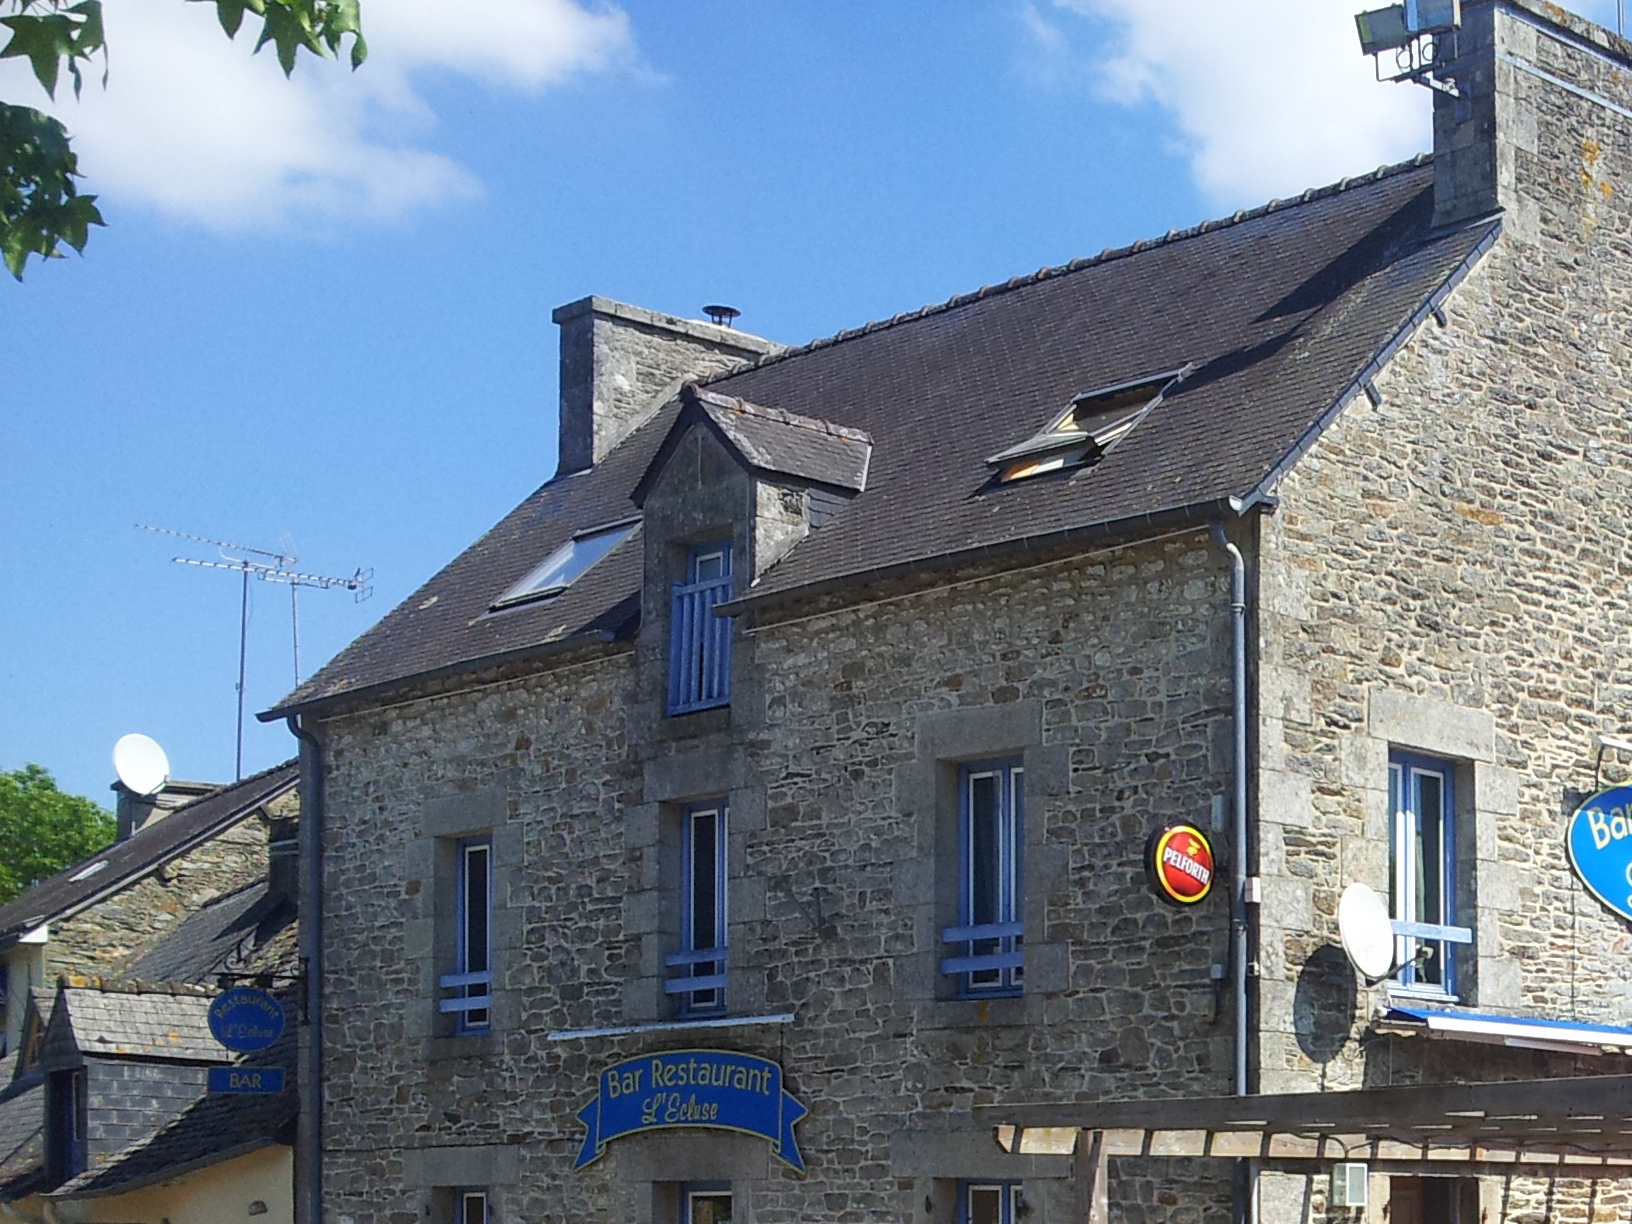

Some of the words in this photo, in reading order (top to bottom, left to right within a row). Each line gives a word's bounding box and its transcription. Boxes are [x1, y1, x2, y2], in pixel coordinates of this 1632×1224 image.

[1163, 847, 1210, 885] PELFORTH
[214, 995, 279, 1018] Restaurant
[229, 1073, 262, 1089] BAR
[607, 1067, 643, 1099] Bar
[652, 1058, 772, 1096] Restaurant
[641, 1092, 720, 1124] L'Ecluse
